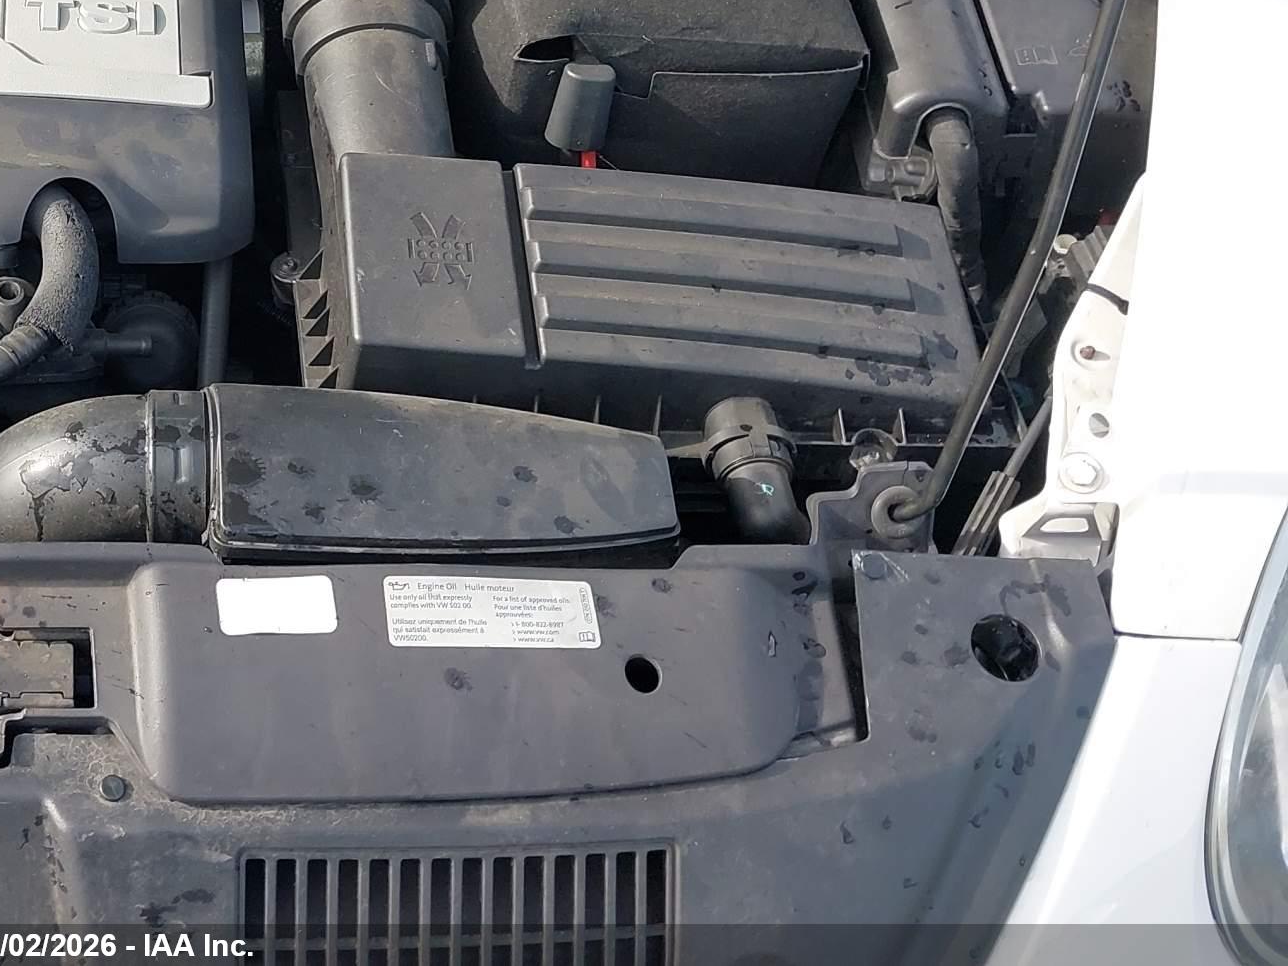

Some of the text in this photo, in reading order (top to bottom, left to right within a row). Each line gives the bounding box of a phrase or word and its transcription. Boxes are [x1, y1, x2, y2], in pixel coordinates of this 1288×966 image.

[417, 582, 444, 592] Engine
[446, 582, 457, 590] Oil
[464, 583, 485, 591] Huile
[403, 593, 418, 602] only
[442, 594, 473, 603] expressly
[528, 597, 558, 605] approved
[390, 602, 419, 610] complies
[417, 618, 457, 627] uniquement
[404, 626, 430, 634] satisfait
